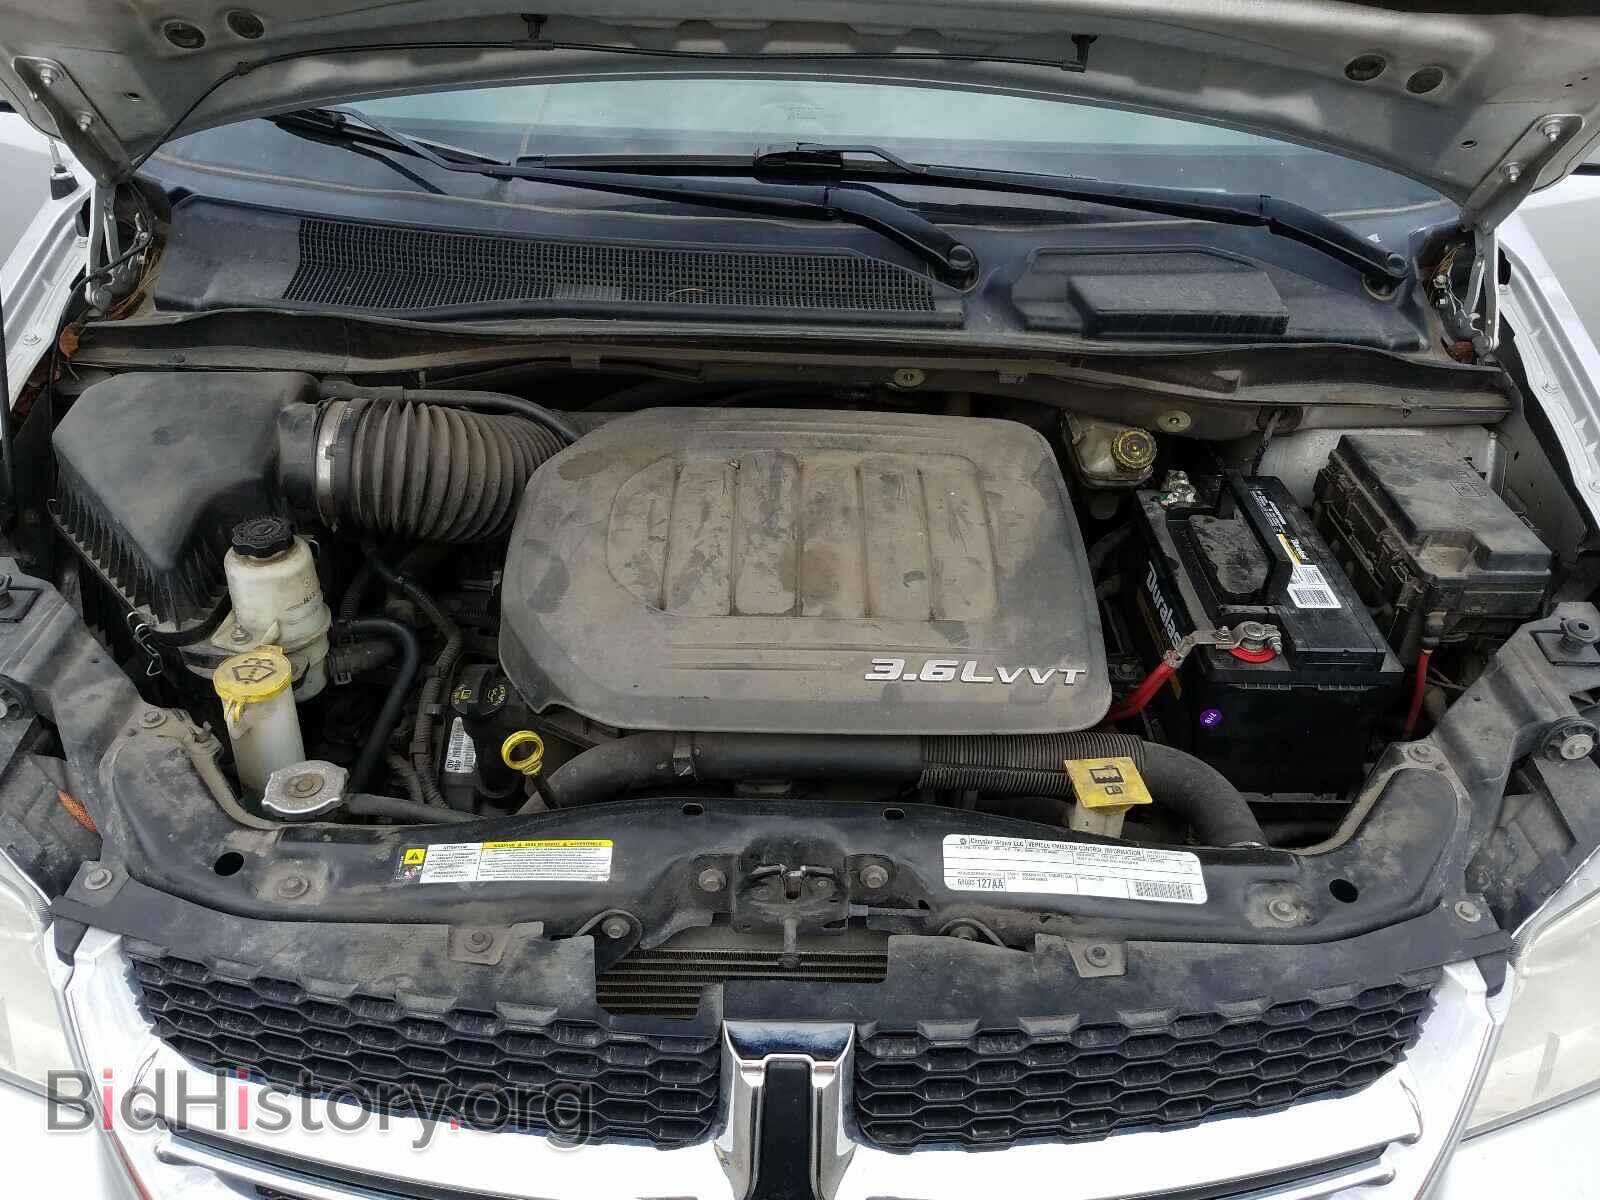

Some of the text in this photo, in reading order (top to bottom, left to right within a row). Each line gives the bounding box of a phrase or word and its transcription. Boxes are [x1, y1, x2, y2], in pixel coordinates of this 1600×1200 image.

[1146, 560, 1182, 650] Duralas
[1027, 841, 1050, 849] VEHICLE
[1051, 843, 1077, 851] EMISSION
[1078, 845, 1101, 853] CONTROL
[1104, 847, 1141, 856] INFORMATION
